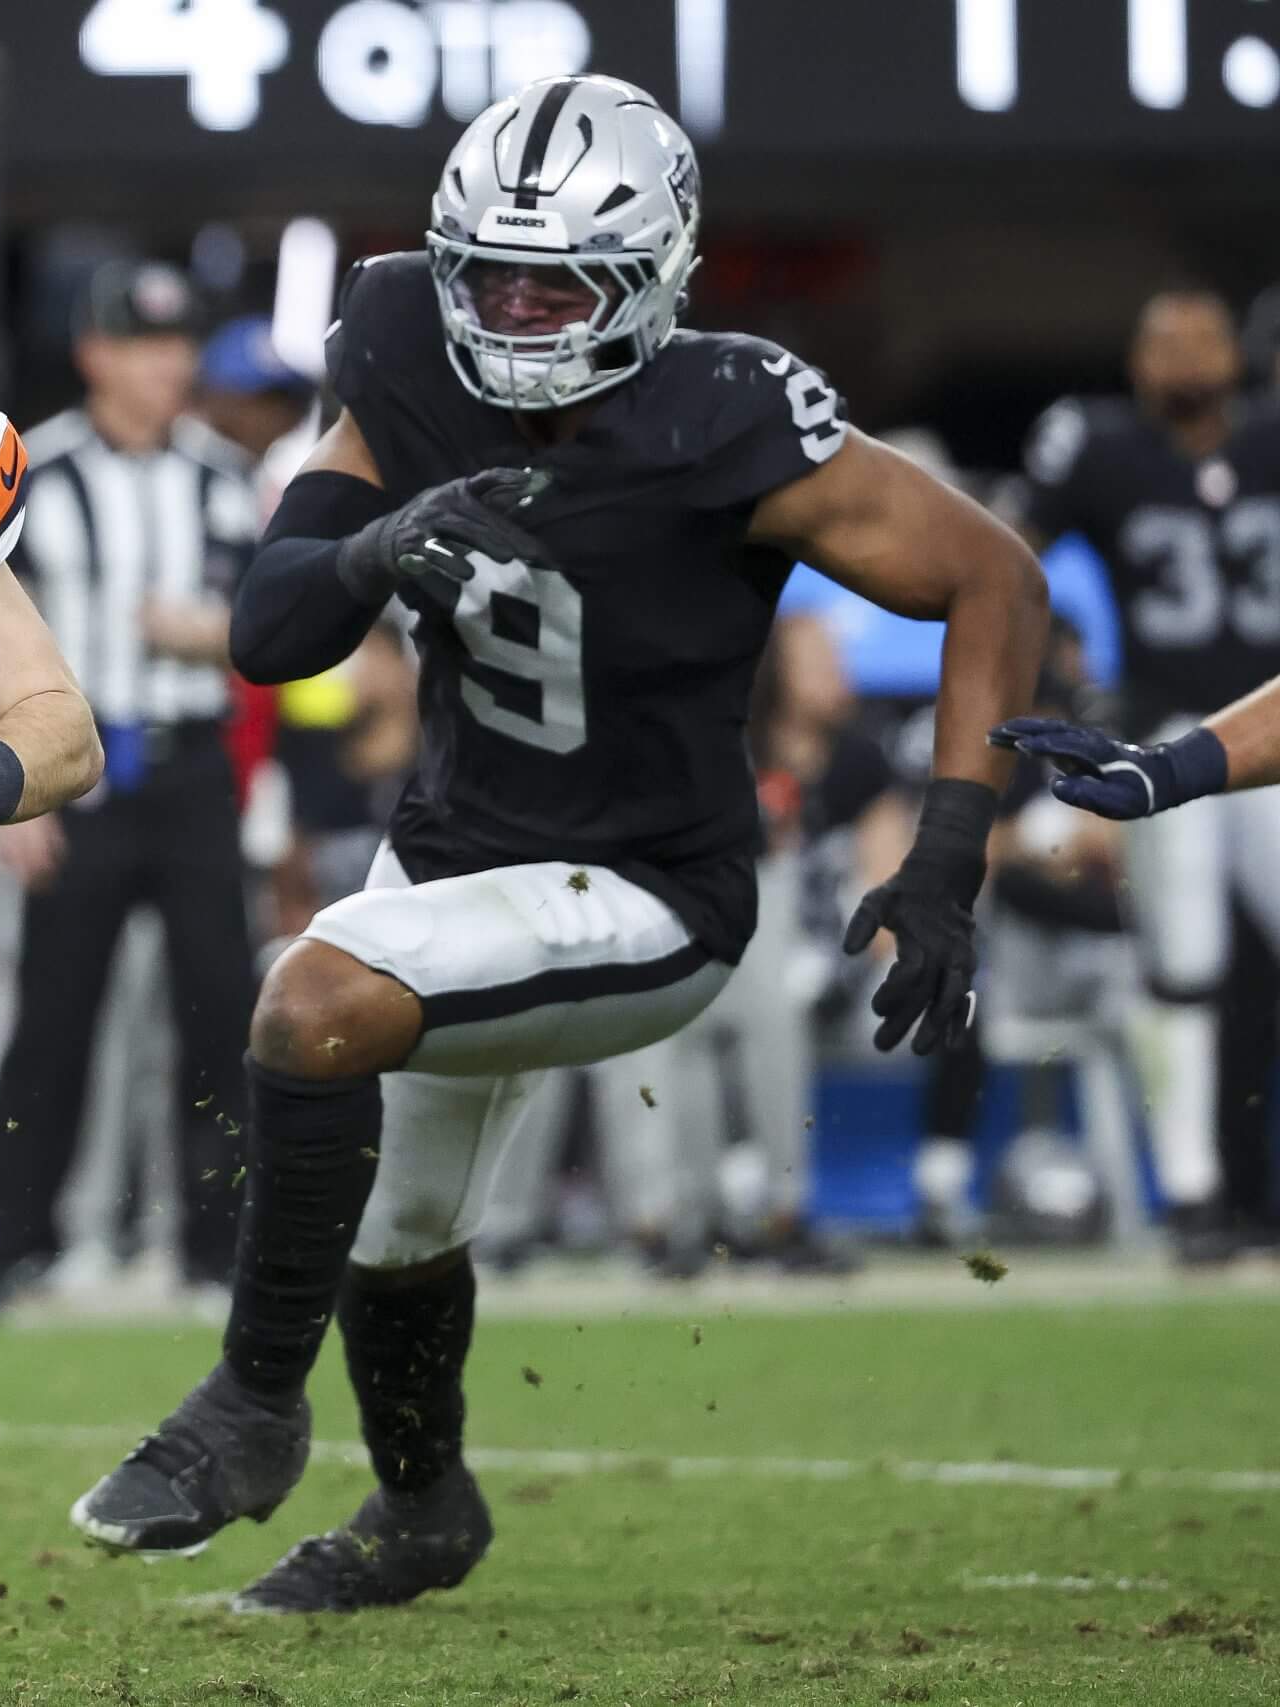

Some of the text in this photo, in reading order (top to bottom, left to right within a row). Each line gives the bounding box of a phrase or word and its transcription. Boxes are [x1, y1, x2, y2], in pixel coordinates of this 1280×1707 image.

[496, 214, 546, 229] RAIDERS
[785, 369, 849, 465] 9
[453, 549, 587, 756] 9
